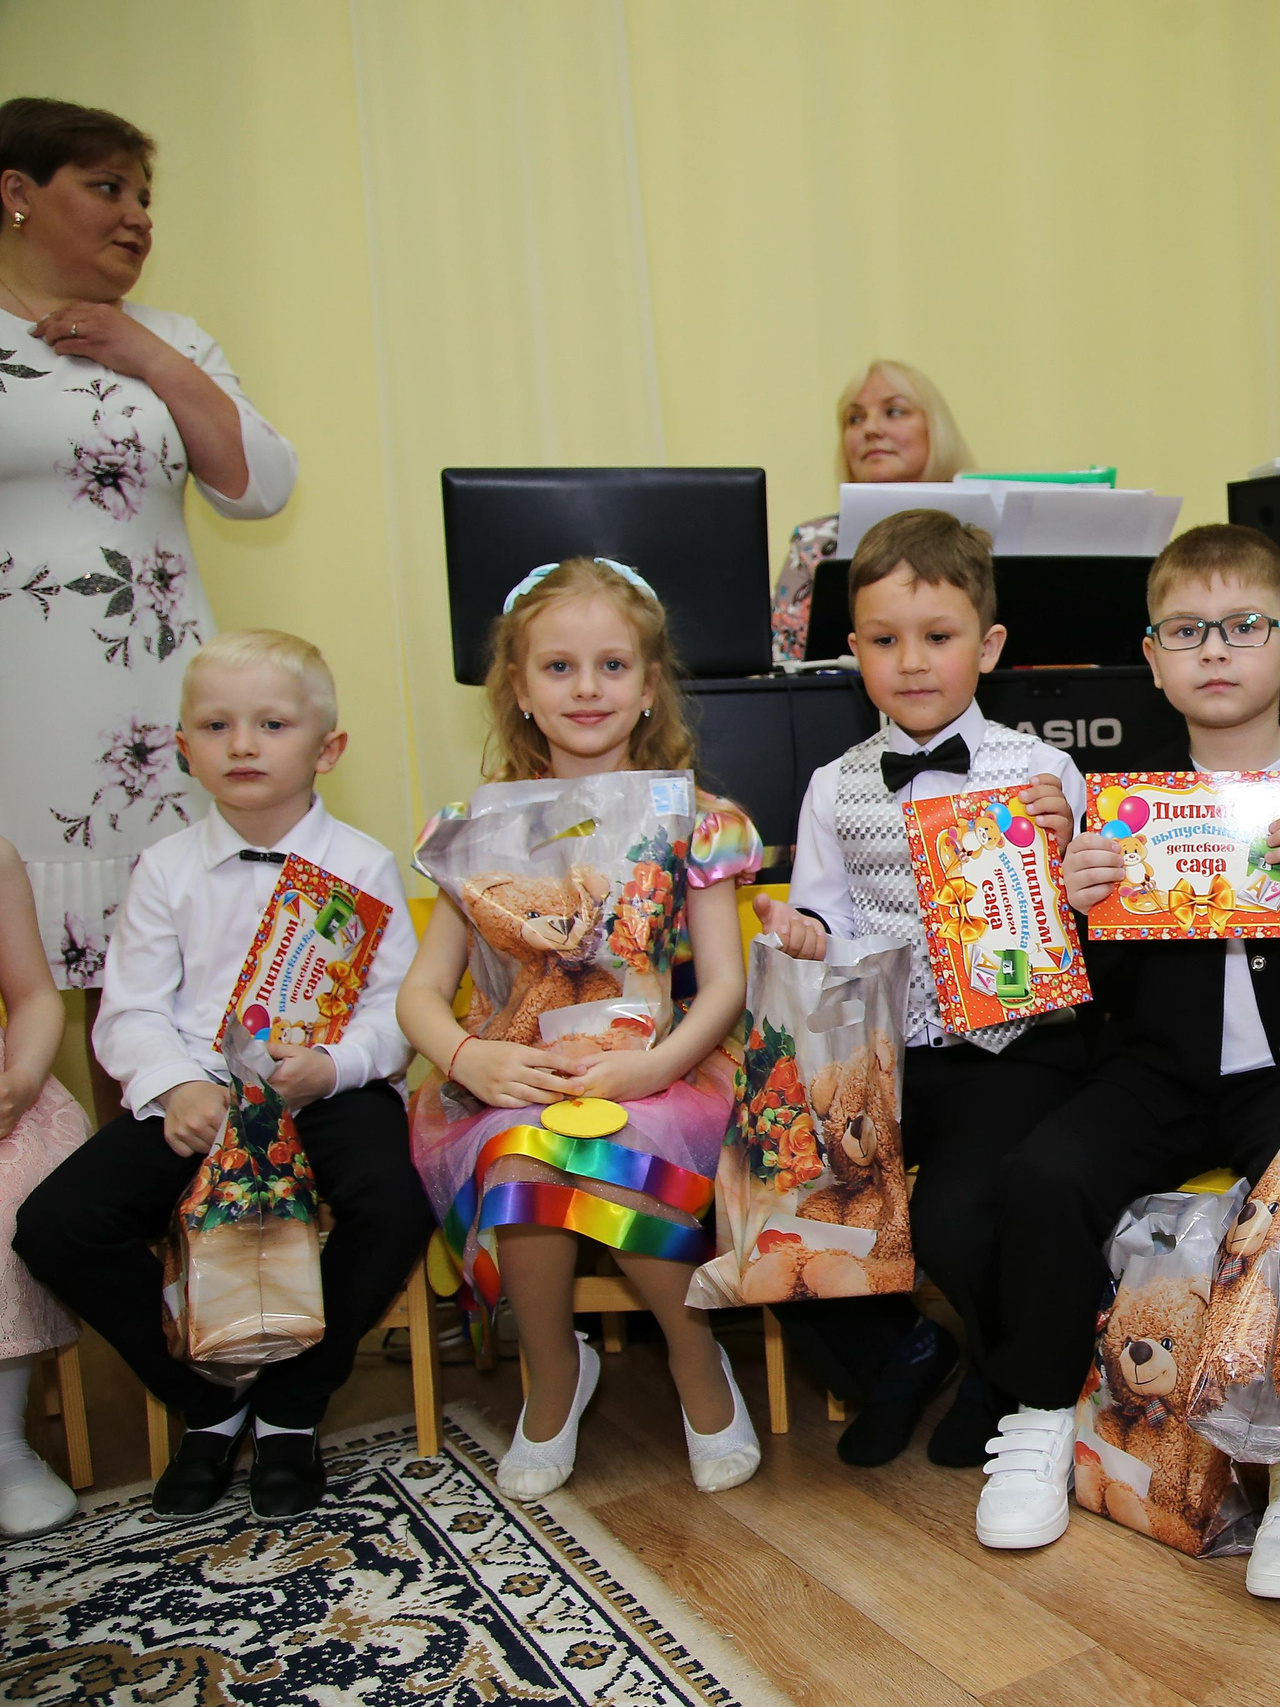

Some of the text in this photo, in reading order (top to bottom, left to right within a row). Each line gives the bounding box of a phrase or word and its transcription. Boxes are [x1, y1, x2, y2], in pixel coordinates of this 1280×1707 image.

[1015, 718, 1122, 748] ASIO
[1166, 842, 1235, 855] детского
[1175, 857, 1227, 877] сада
[981, 879, 1003, 931] сада
[993, 868, 1017, 936] детского
[998, 852, 1030, 949] выпускника
[1019, 848, 1053, 945] Диплом
[255, 918, 299, 1006] Диплом
[302, 956, 327, 1001] сада
